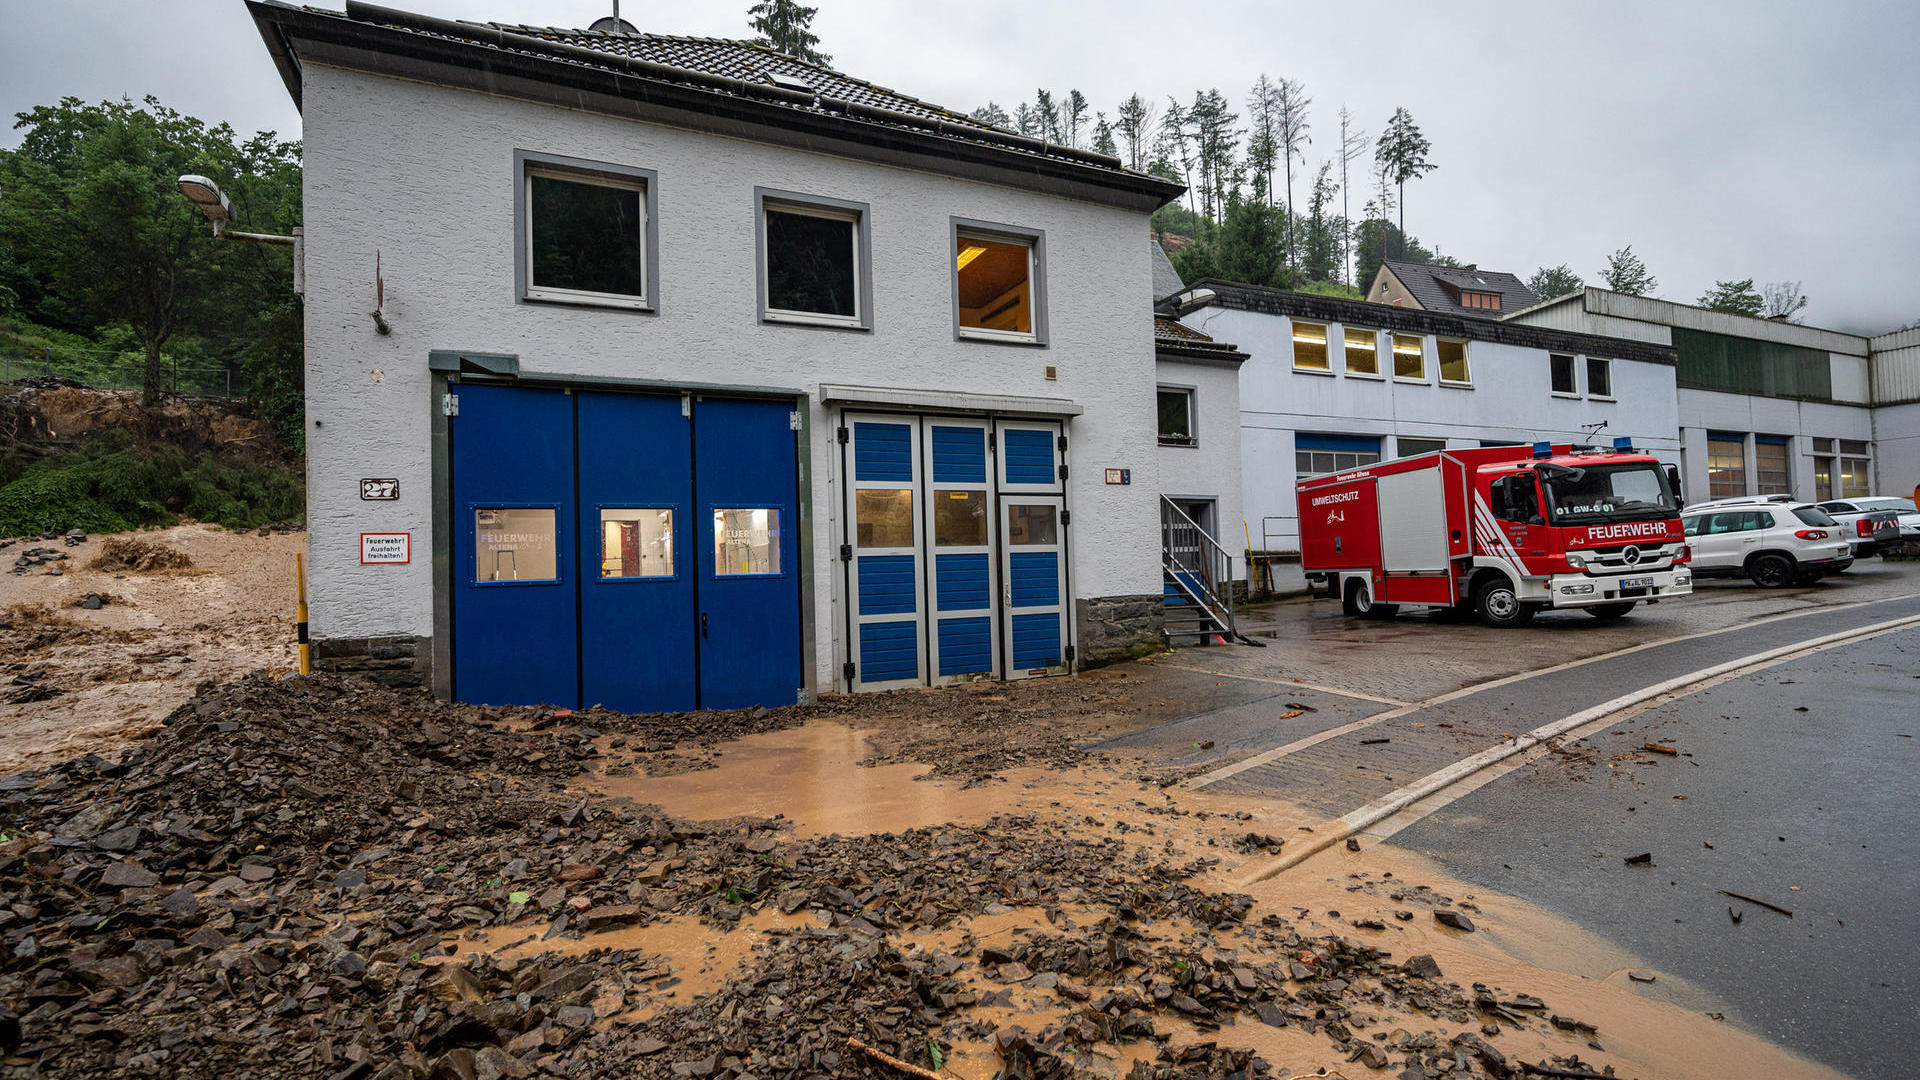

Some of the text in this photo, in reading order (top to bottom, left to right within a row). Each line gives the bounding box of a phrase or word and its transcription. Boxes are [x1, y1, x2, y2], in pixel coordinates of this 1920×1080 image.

[364, 482, 395, 497] 27
[1312, 491, 1359, 506] UMWELTSCHUTZ
[1573, 505, 1601, 514] GW-G
[1602, 504, 1615, 512] 01
[481, 532, 553, 543] FEUERWEHR
[1588, 522, 1667, 540] FEUERWEHR
